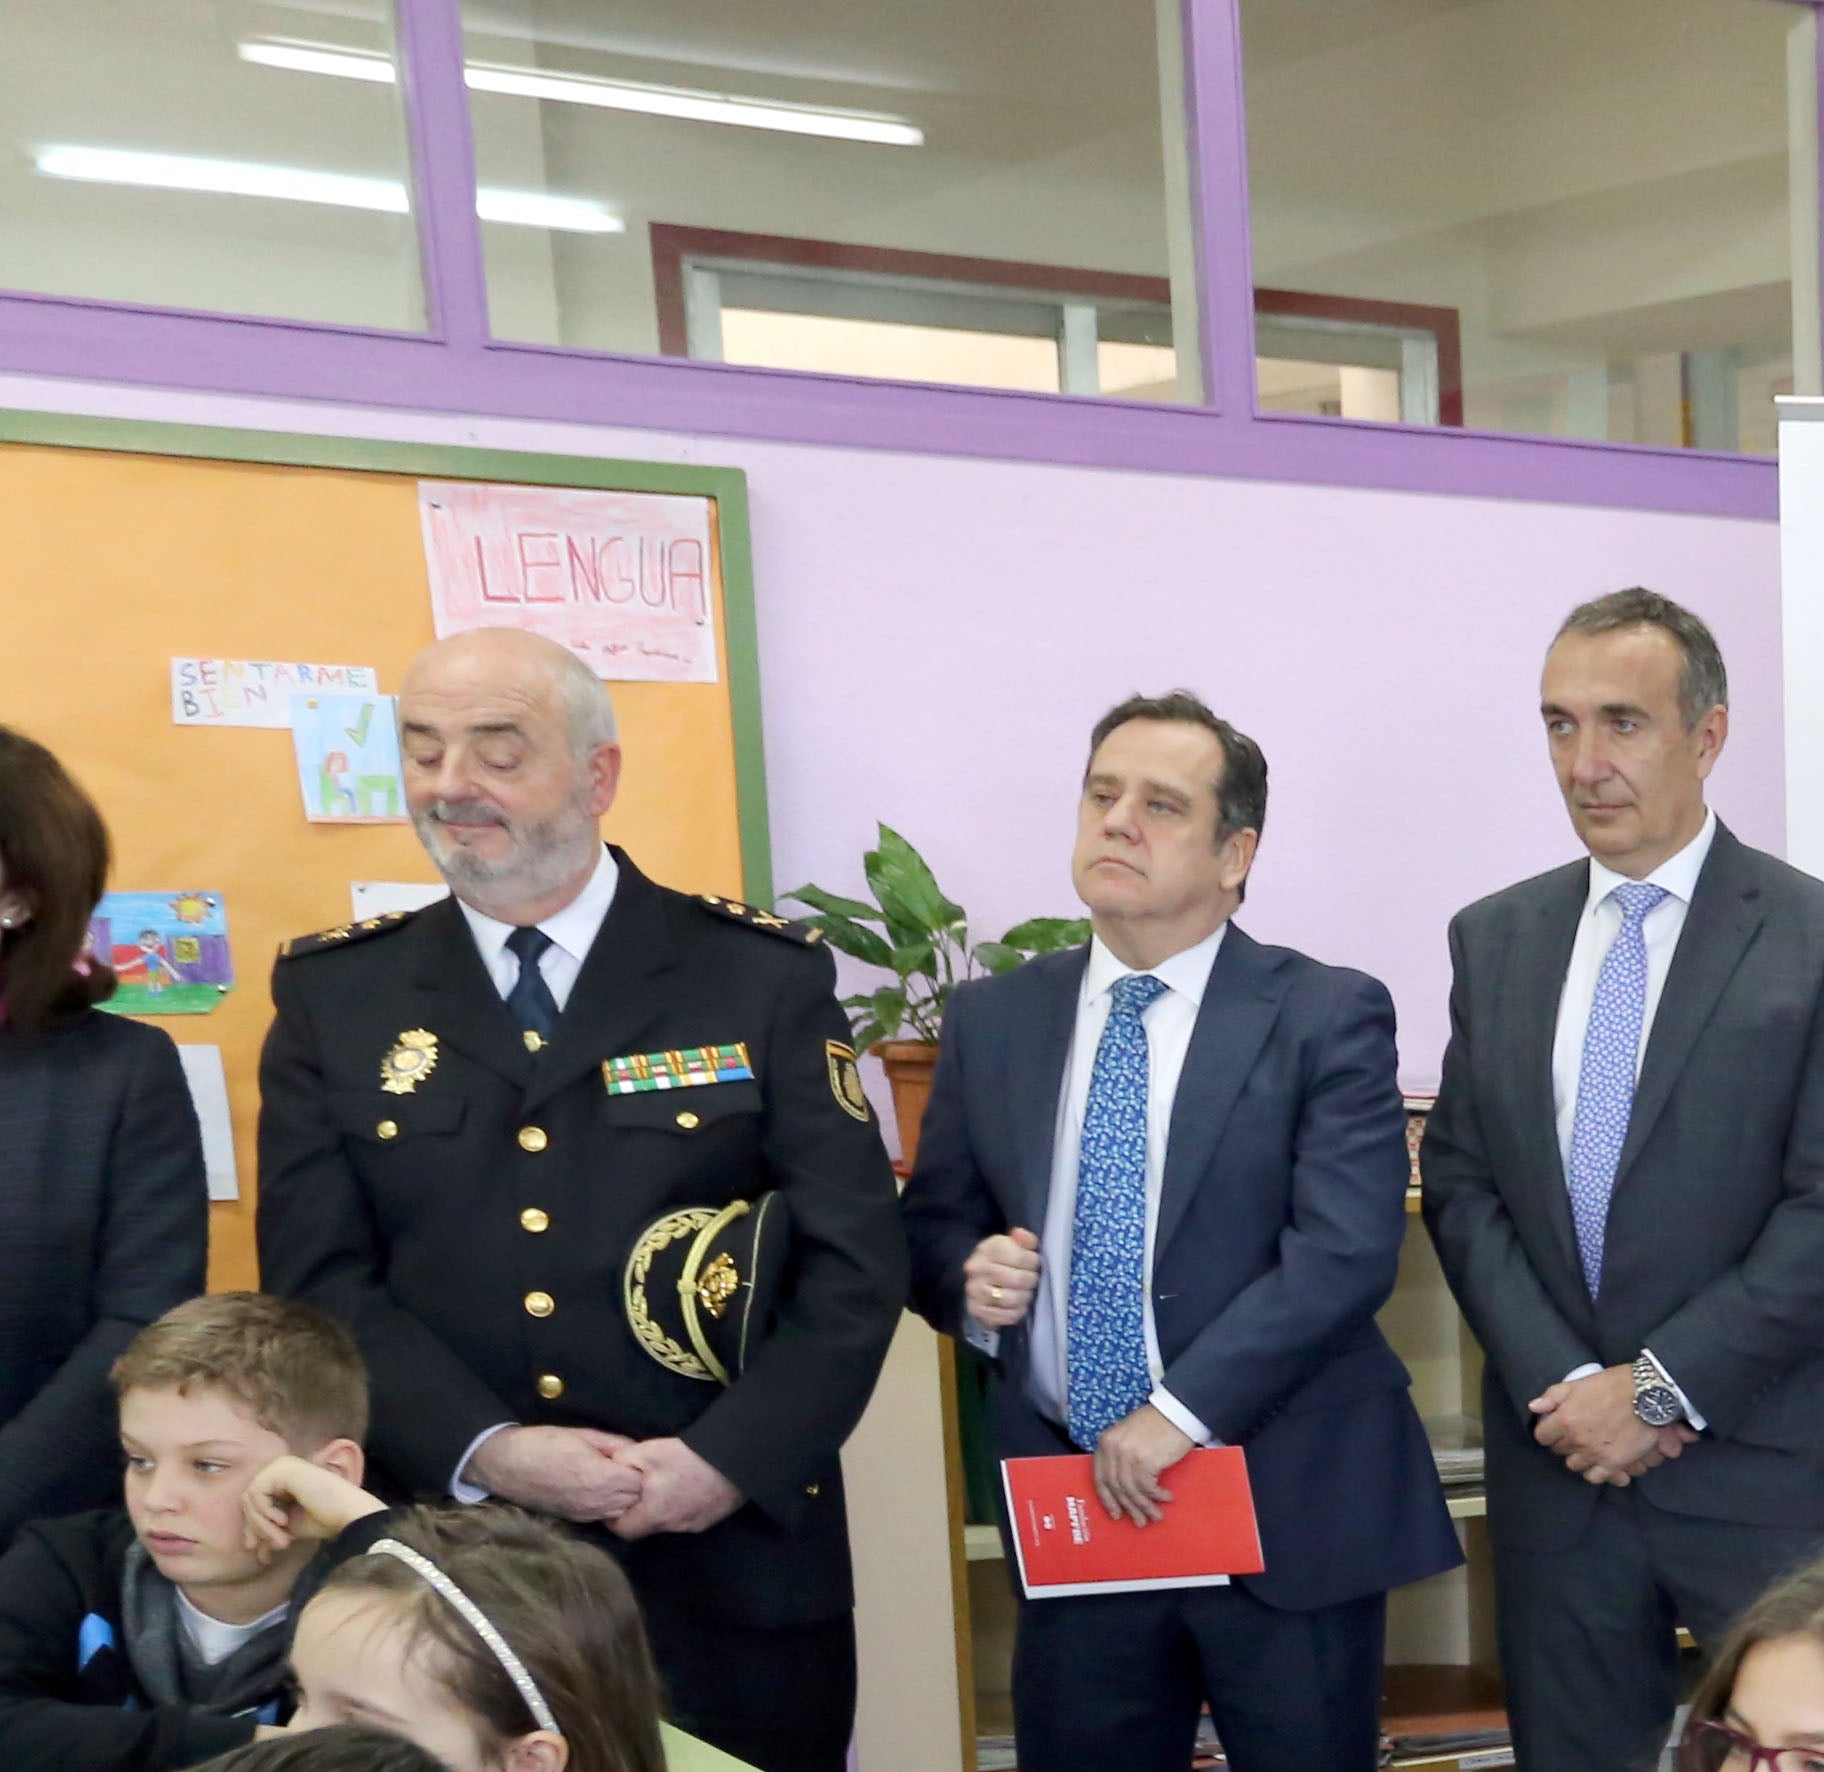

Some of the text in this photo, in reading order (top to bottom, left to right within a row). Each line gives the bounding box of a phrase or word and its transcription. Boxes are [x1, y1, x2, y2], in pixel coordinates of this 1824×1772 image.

[474, 533, 706, 613] LENGUA
[178, 660, 374, 689] SENTARME
[180, 683, 268, 719] BIEN
